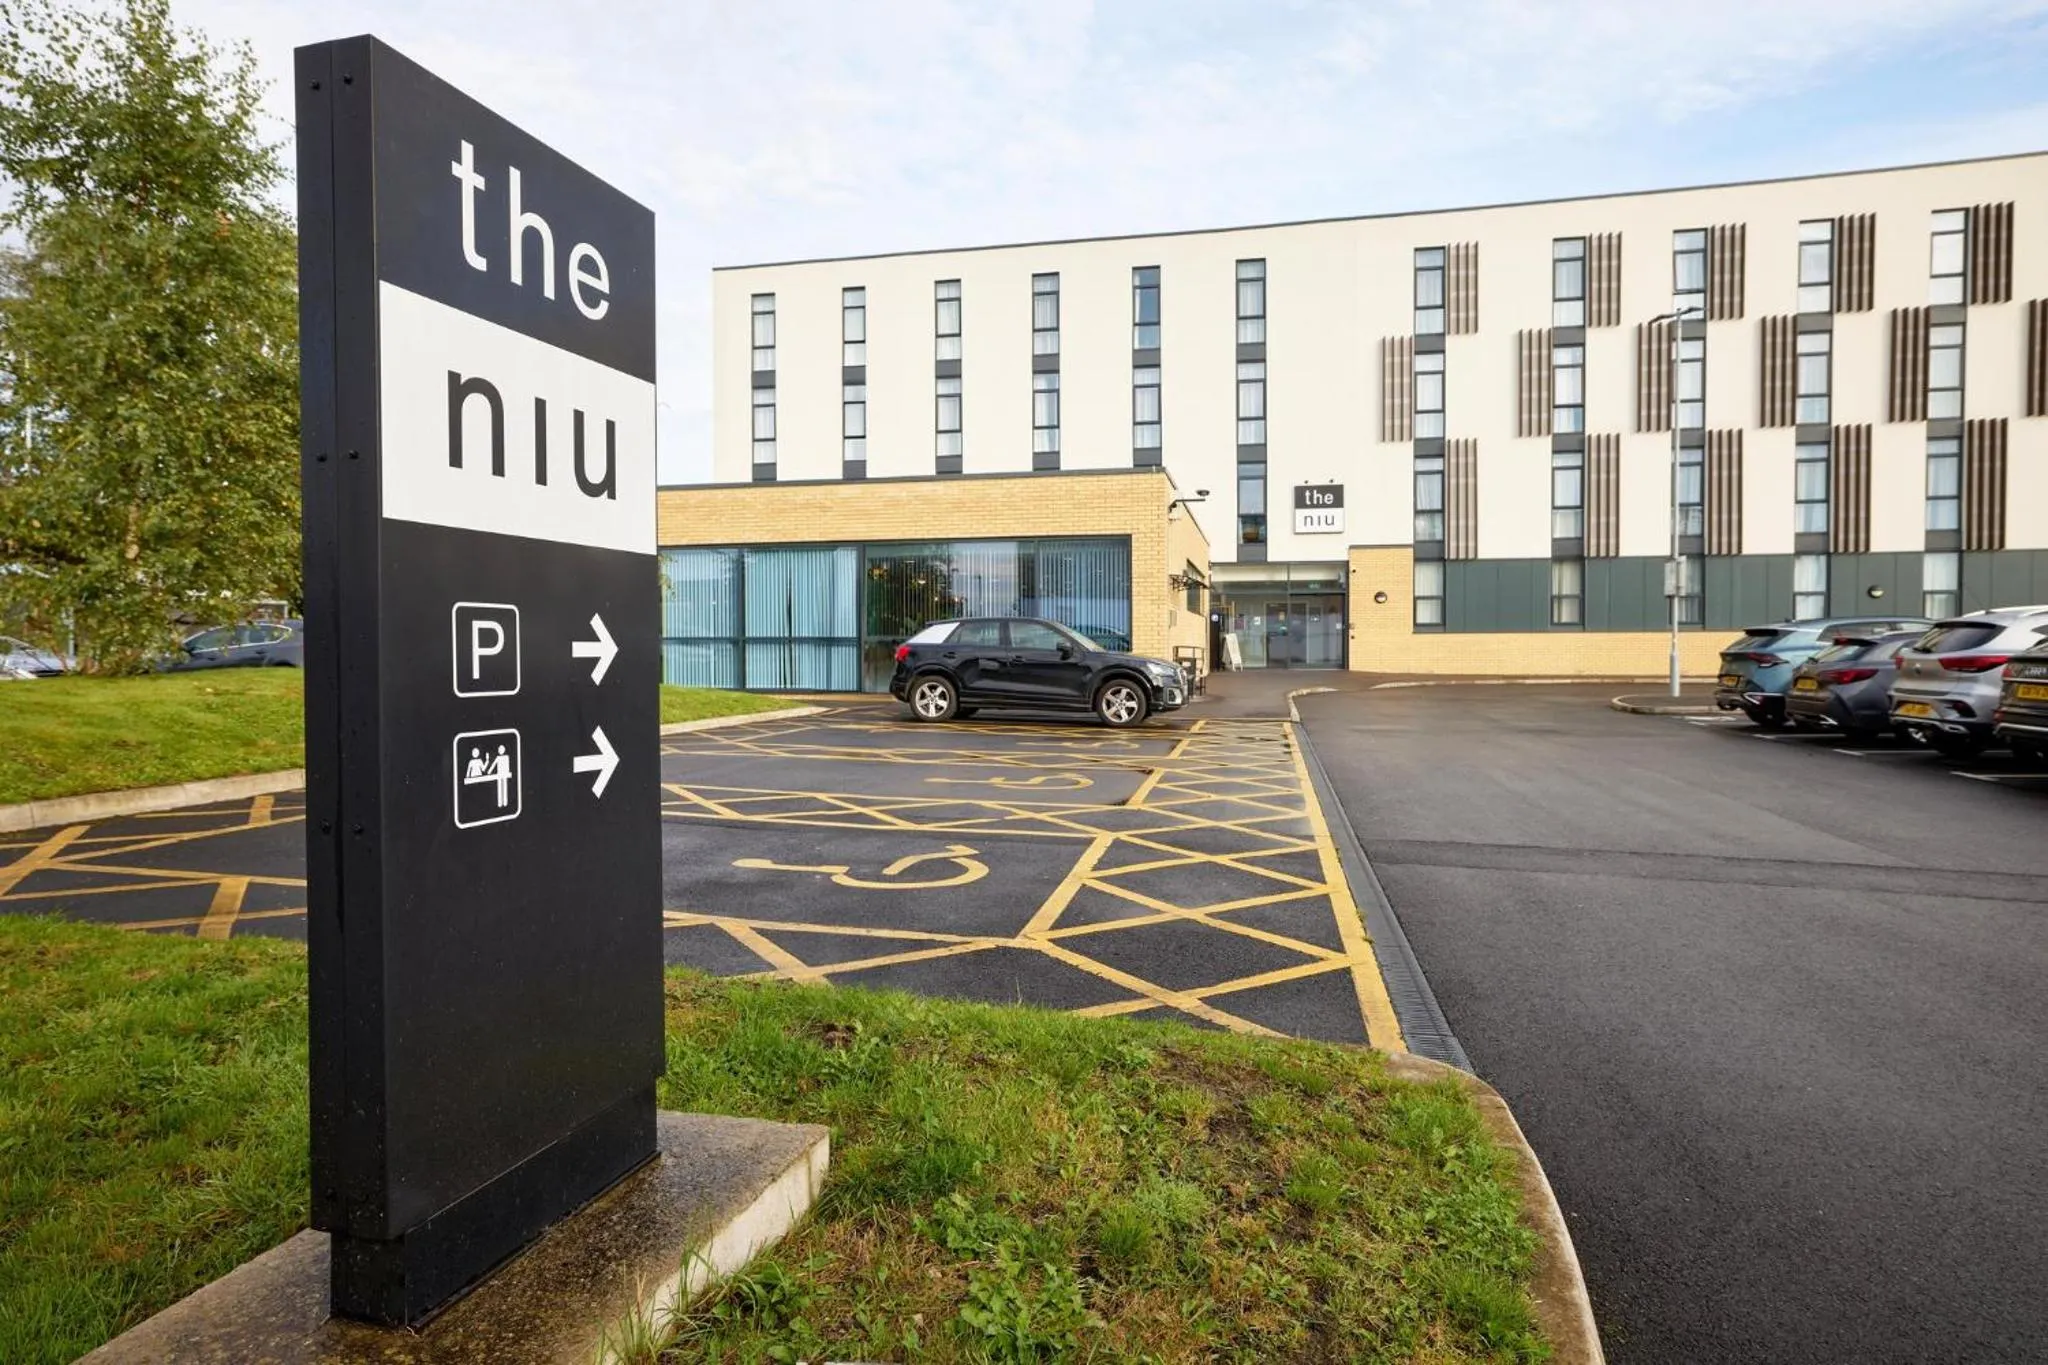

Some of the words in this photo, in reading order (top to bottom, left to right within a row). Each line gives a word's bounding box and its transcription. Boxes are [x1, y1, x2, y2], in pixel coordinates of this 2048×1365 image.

[451, 139, 610, 321] the
[448, 370, 617, 501] niu
[1304, 489, 1334, 505] the
[1304, 515, 1335, 527] niu
[471, 619, 505, 680] P
